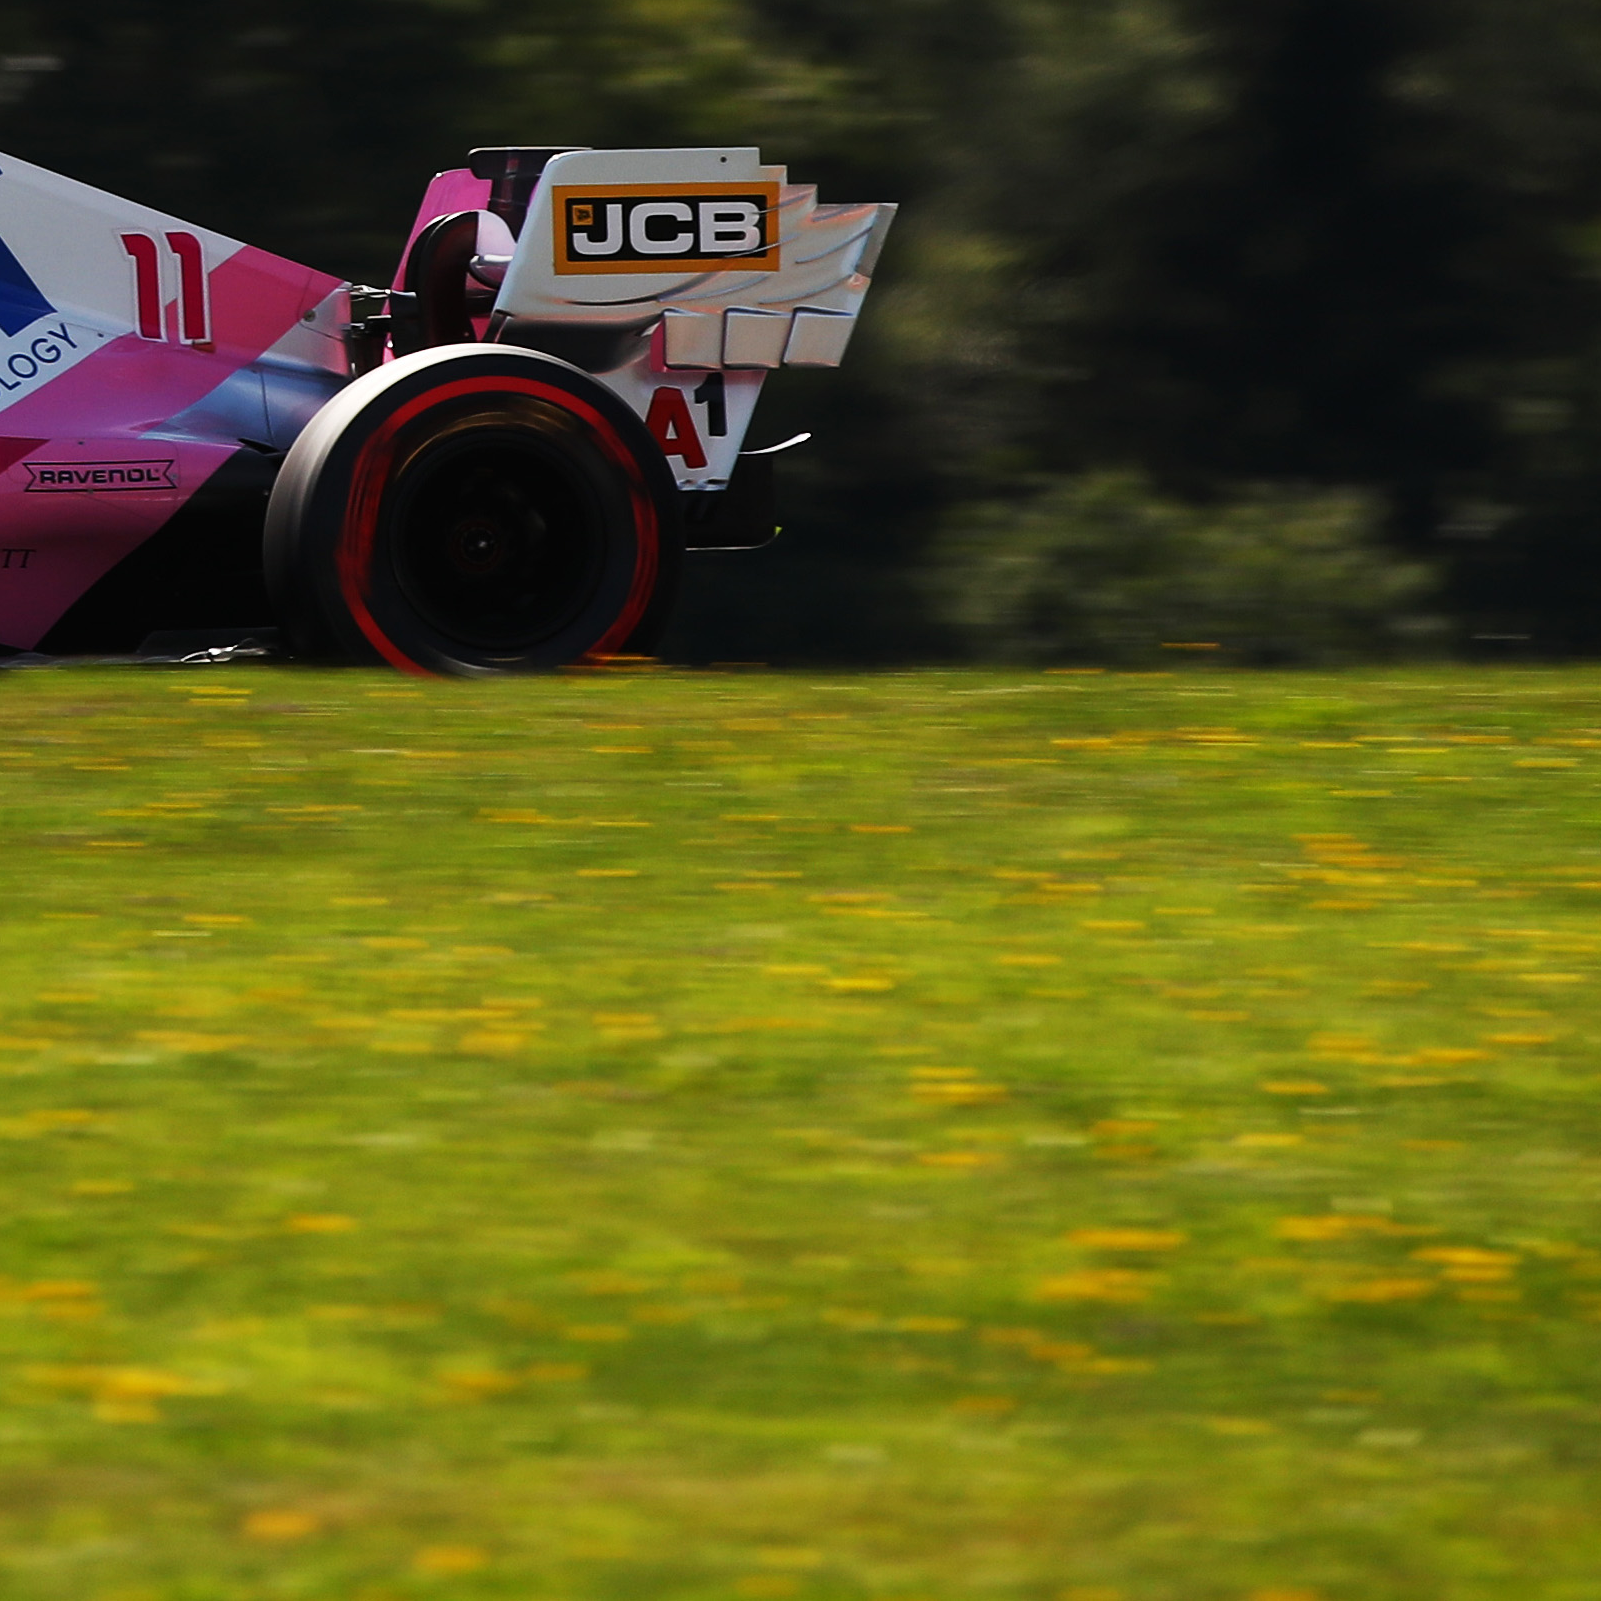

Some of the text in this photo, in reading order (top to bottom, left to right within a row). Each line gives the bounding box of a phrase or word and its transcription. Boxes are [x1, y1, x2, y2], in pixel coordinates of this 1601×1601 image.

[572, 201, 761, 255] JCB
[119, 231, 208, 341] 11
[39, 468, 160, 485] RAVENOL
